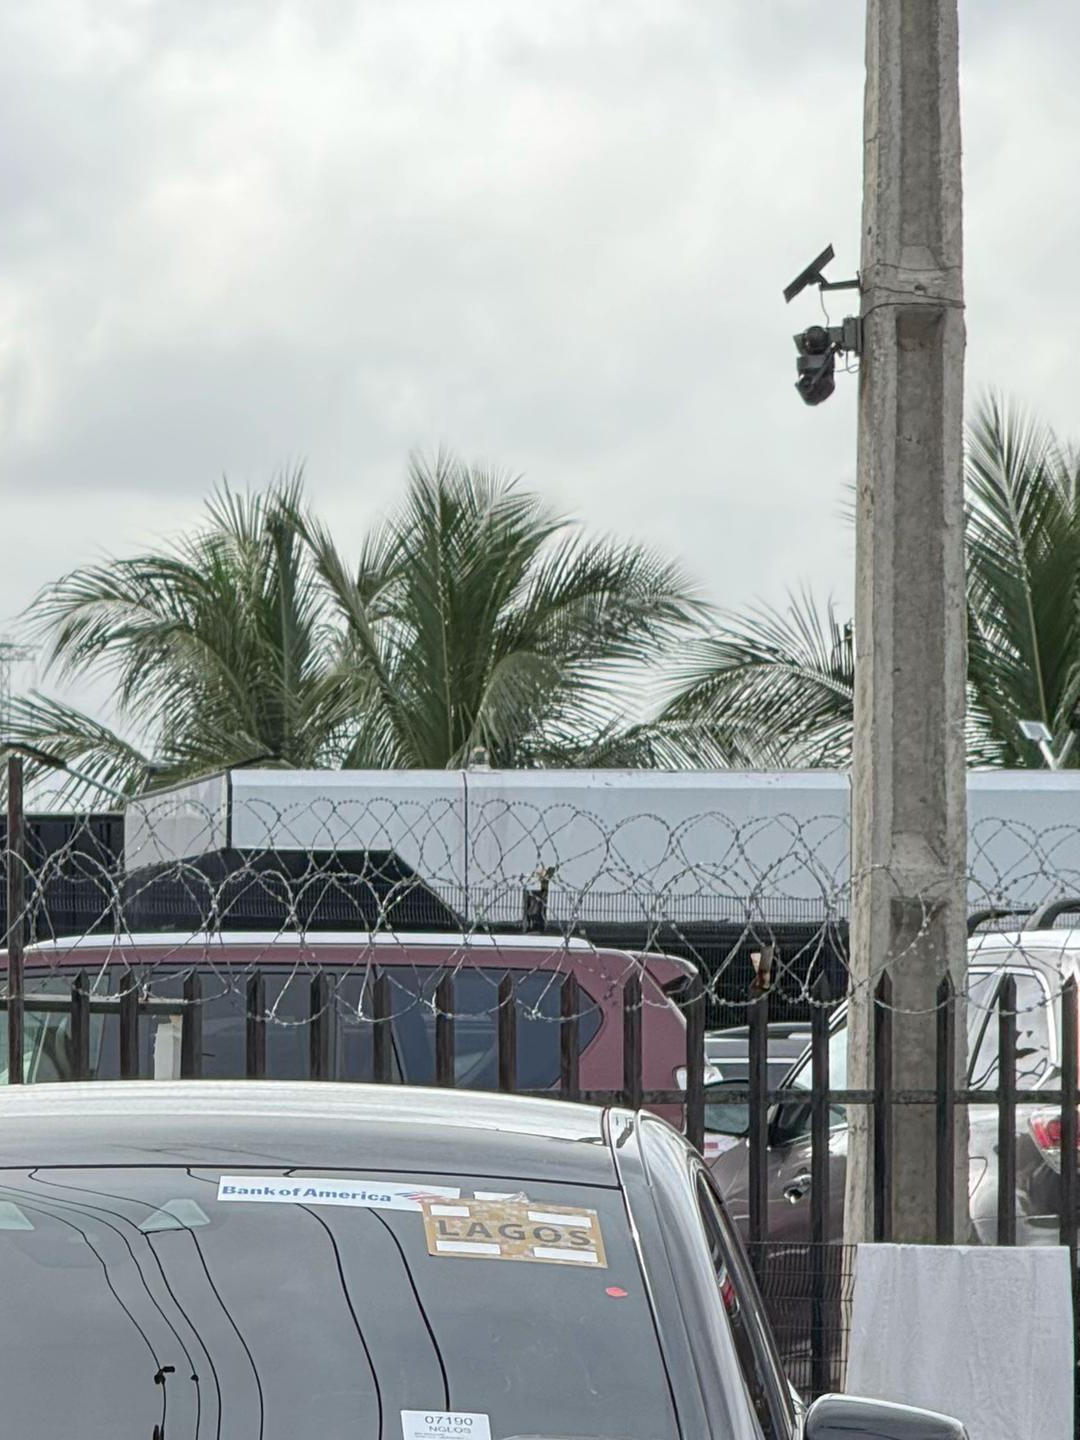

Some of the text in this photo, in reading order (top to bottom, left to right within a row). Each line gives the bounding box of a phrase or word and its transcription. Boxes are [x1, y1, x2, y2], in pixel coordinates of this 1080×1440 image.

[222, 1186, 276, 1196] Bank
[303, 1187, 392, 1203] America
[438, 1219, 591, 1246] LAGOS
[424, 1415, 473, 1426] 07190
